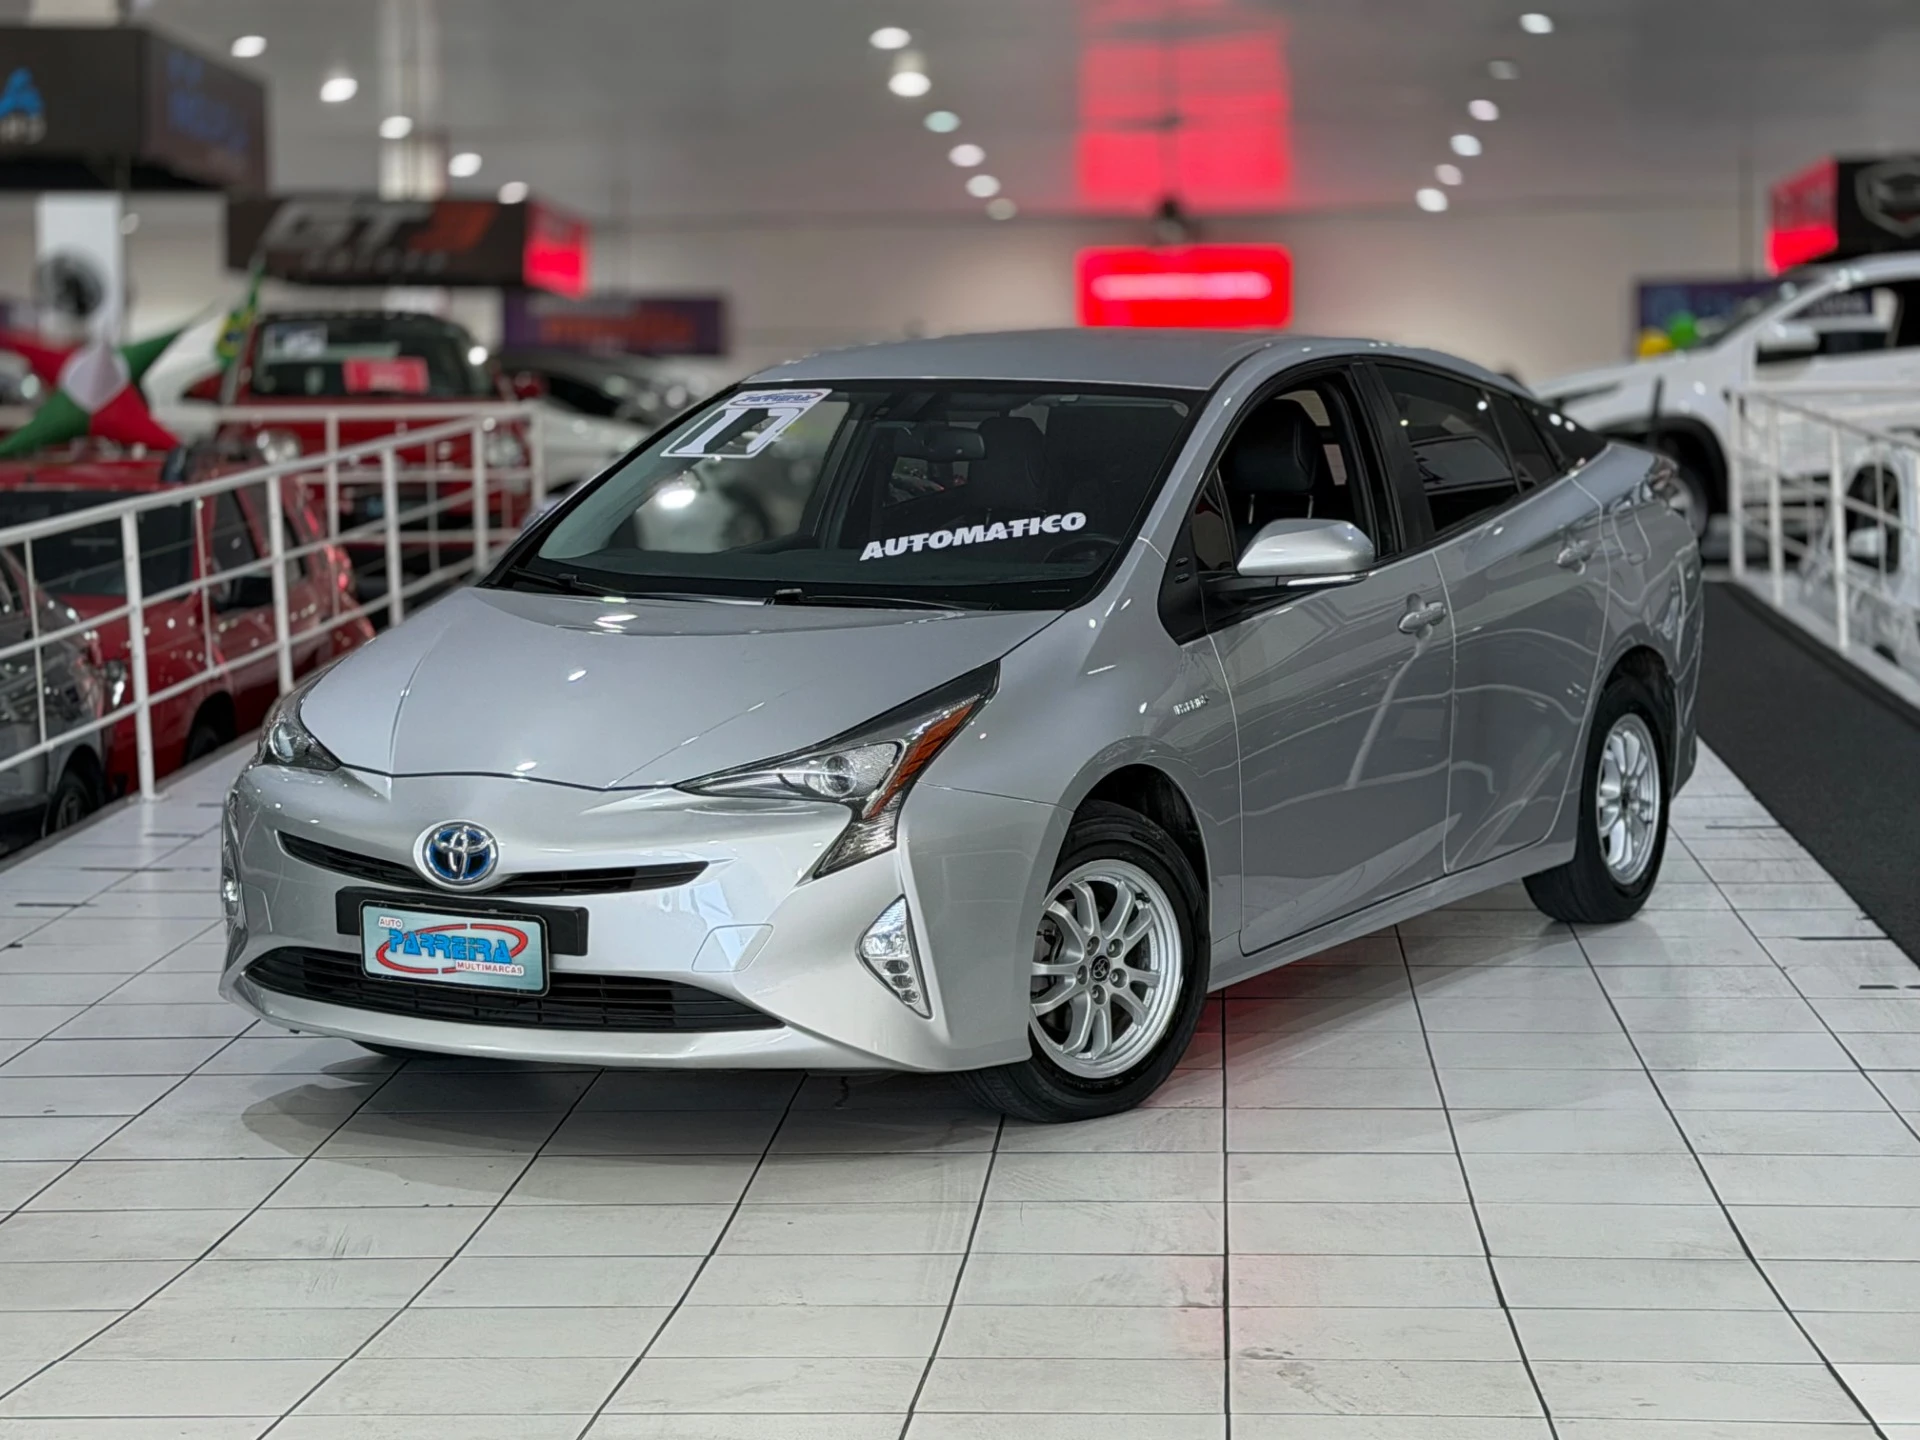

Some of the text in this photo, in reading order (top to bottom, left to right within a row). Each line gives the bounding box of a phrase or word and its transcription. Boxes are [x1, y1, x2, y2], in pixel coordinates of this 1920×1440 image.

[860, 511, 1087, 561] AUTOMATICO
[380, 918, 402, 928] AUTO
[388, 929, 512, 964] PARREIRA
[457, 962, 522, 975] MULTIMARCAS
